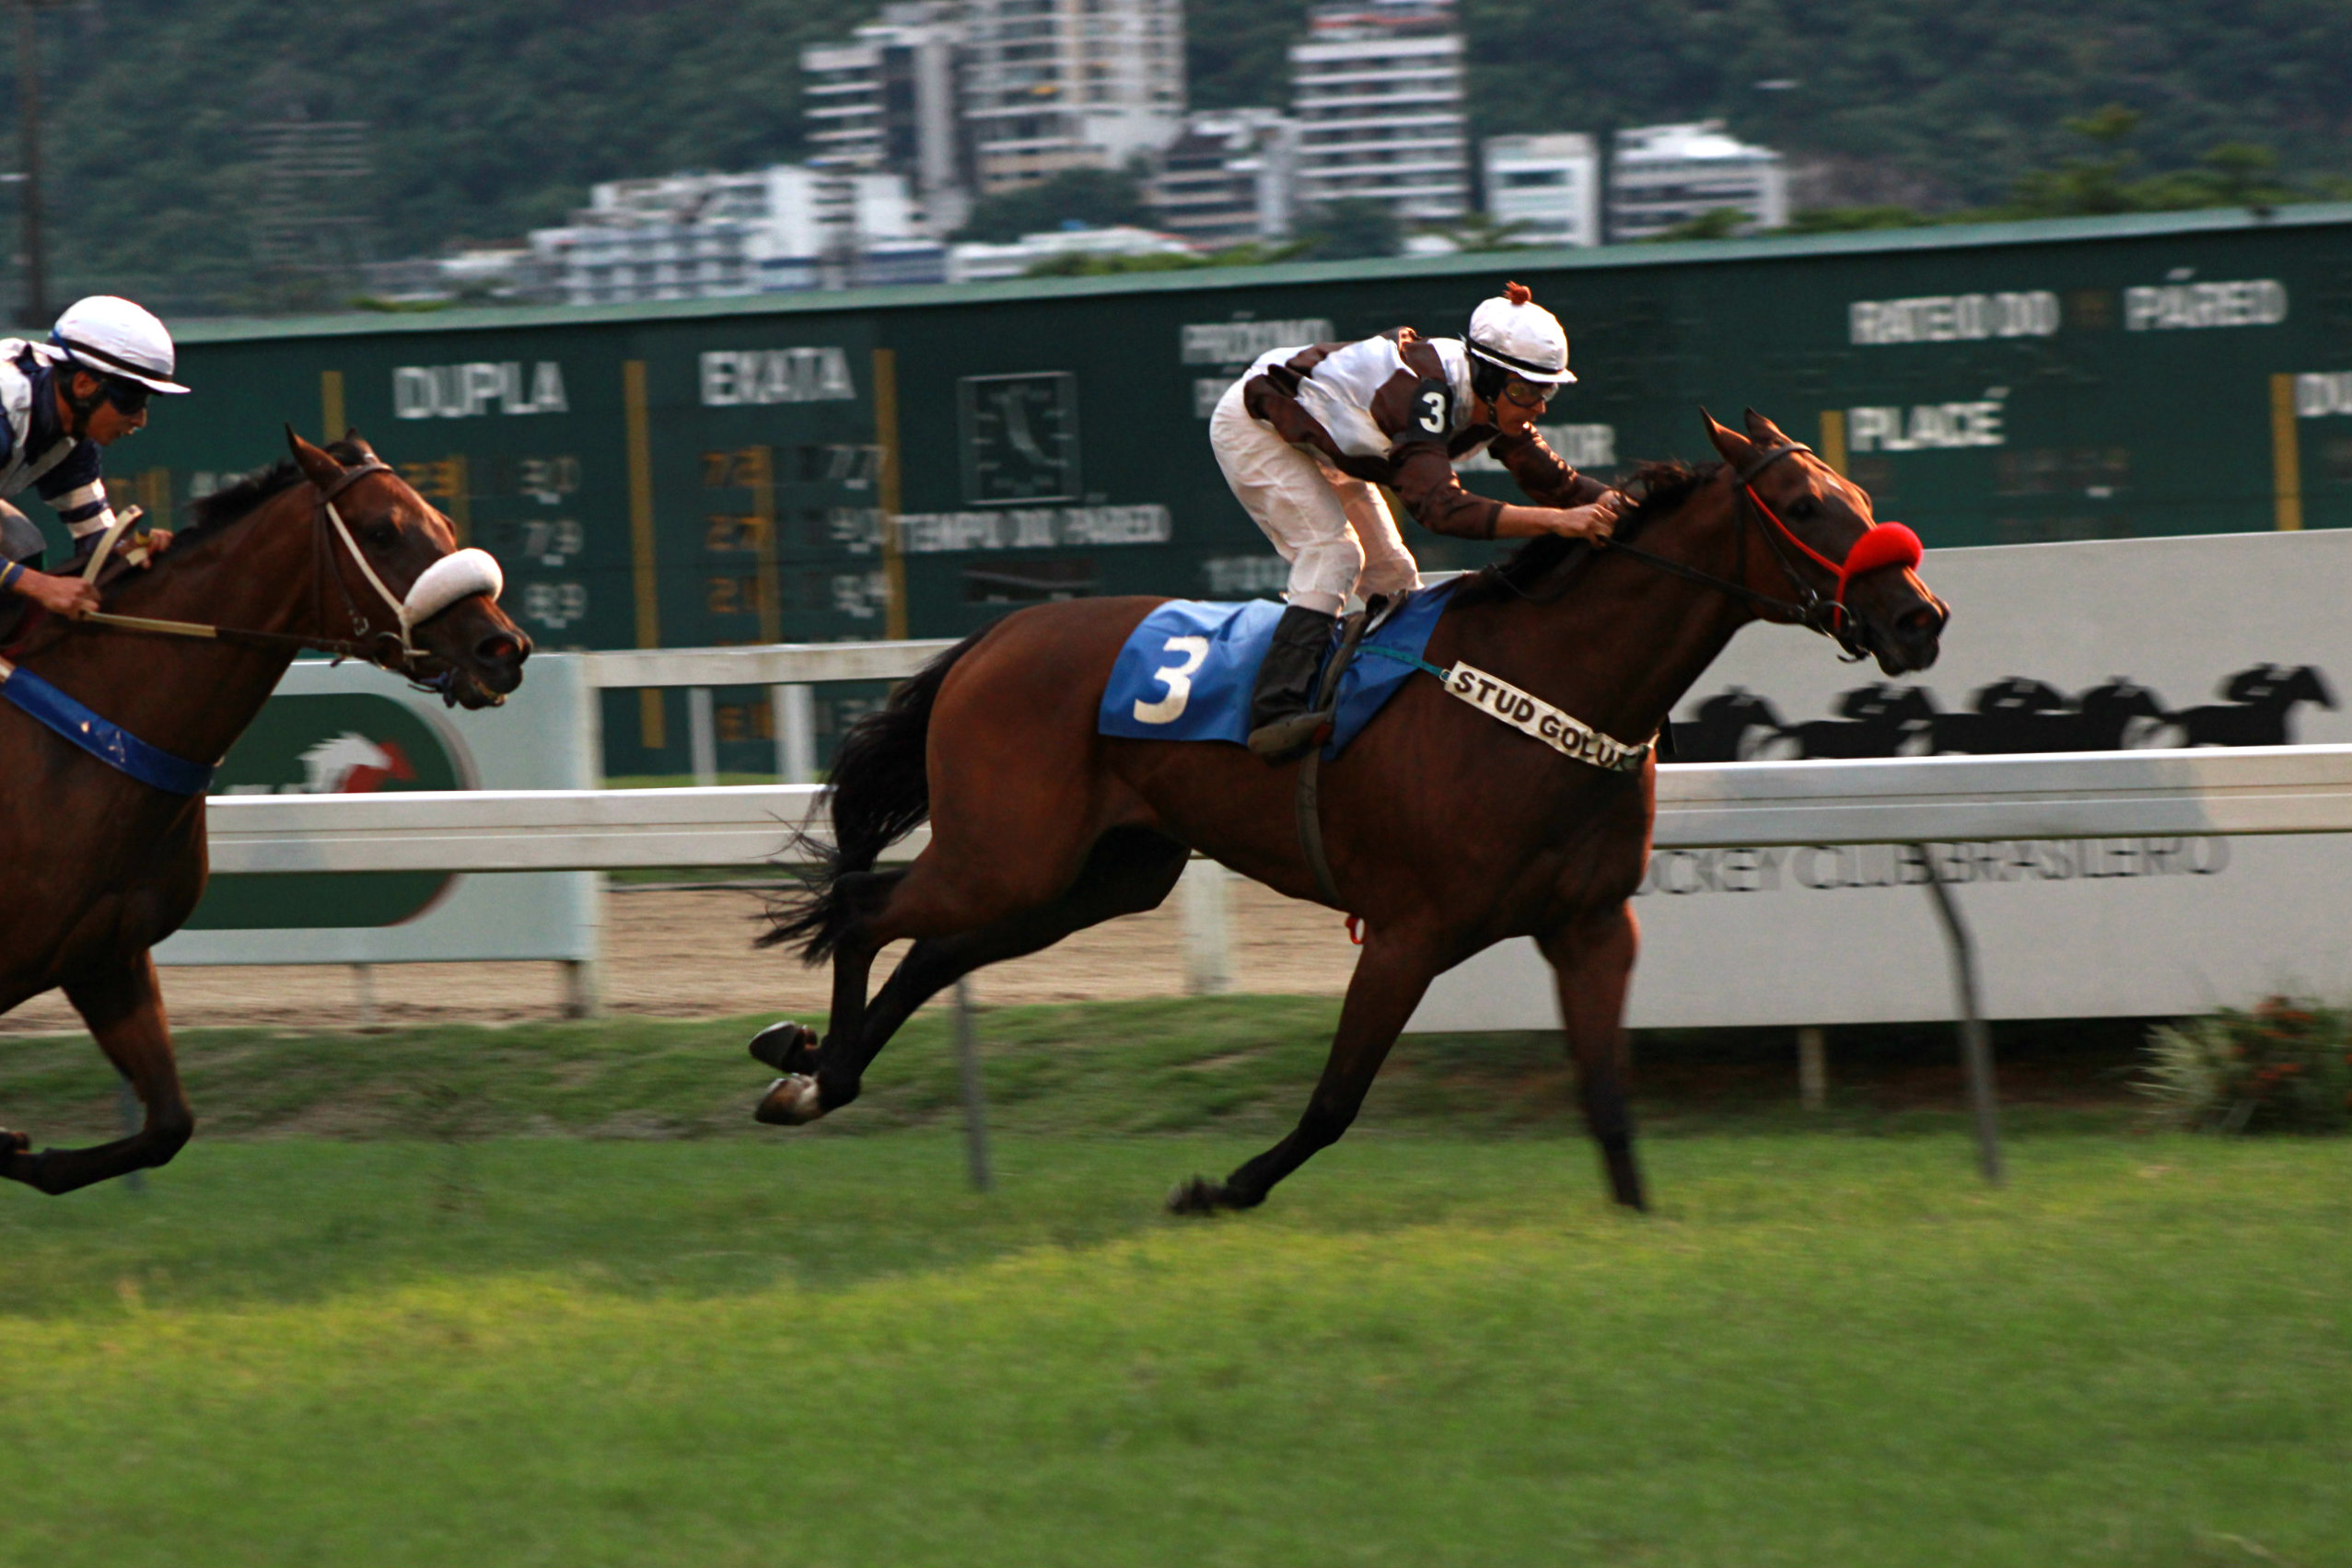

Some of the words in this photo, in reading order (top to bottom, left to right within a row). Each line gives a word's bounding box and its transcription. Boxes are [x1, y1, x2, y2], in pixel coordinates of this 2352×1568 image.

[1849, 292, 1991, 344] RATEIO
[1993, 290, 2061, 338] DO
[2125, 269, 2288, 331] PÁREO
[392, 361, 569, 419] DUPLA
[699, 346, 857, 405] EXATA
[1419, 391, 1446, 434] 3
[1849, 387, 2009, 452] PLACÉ
[886, 508, 1007, 552] TEMPO
[1008, 507, 1060, 549] DO
[1062, 494, 1171, 546] PÁREO
[1134, 636, 1210, 724] 3
[1454, 670, 1536, 724] STUD
